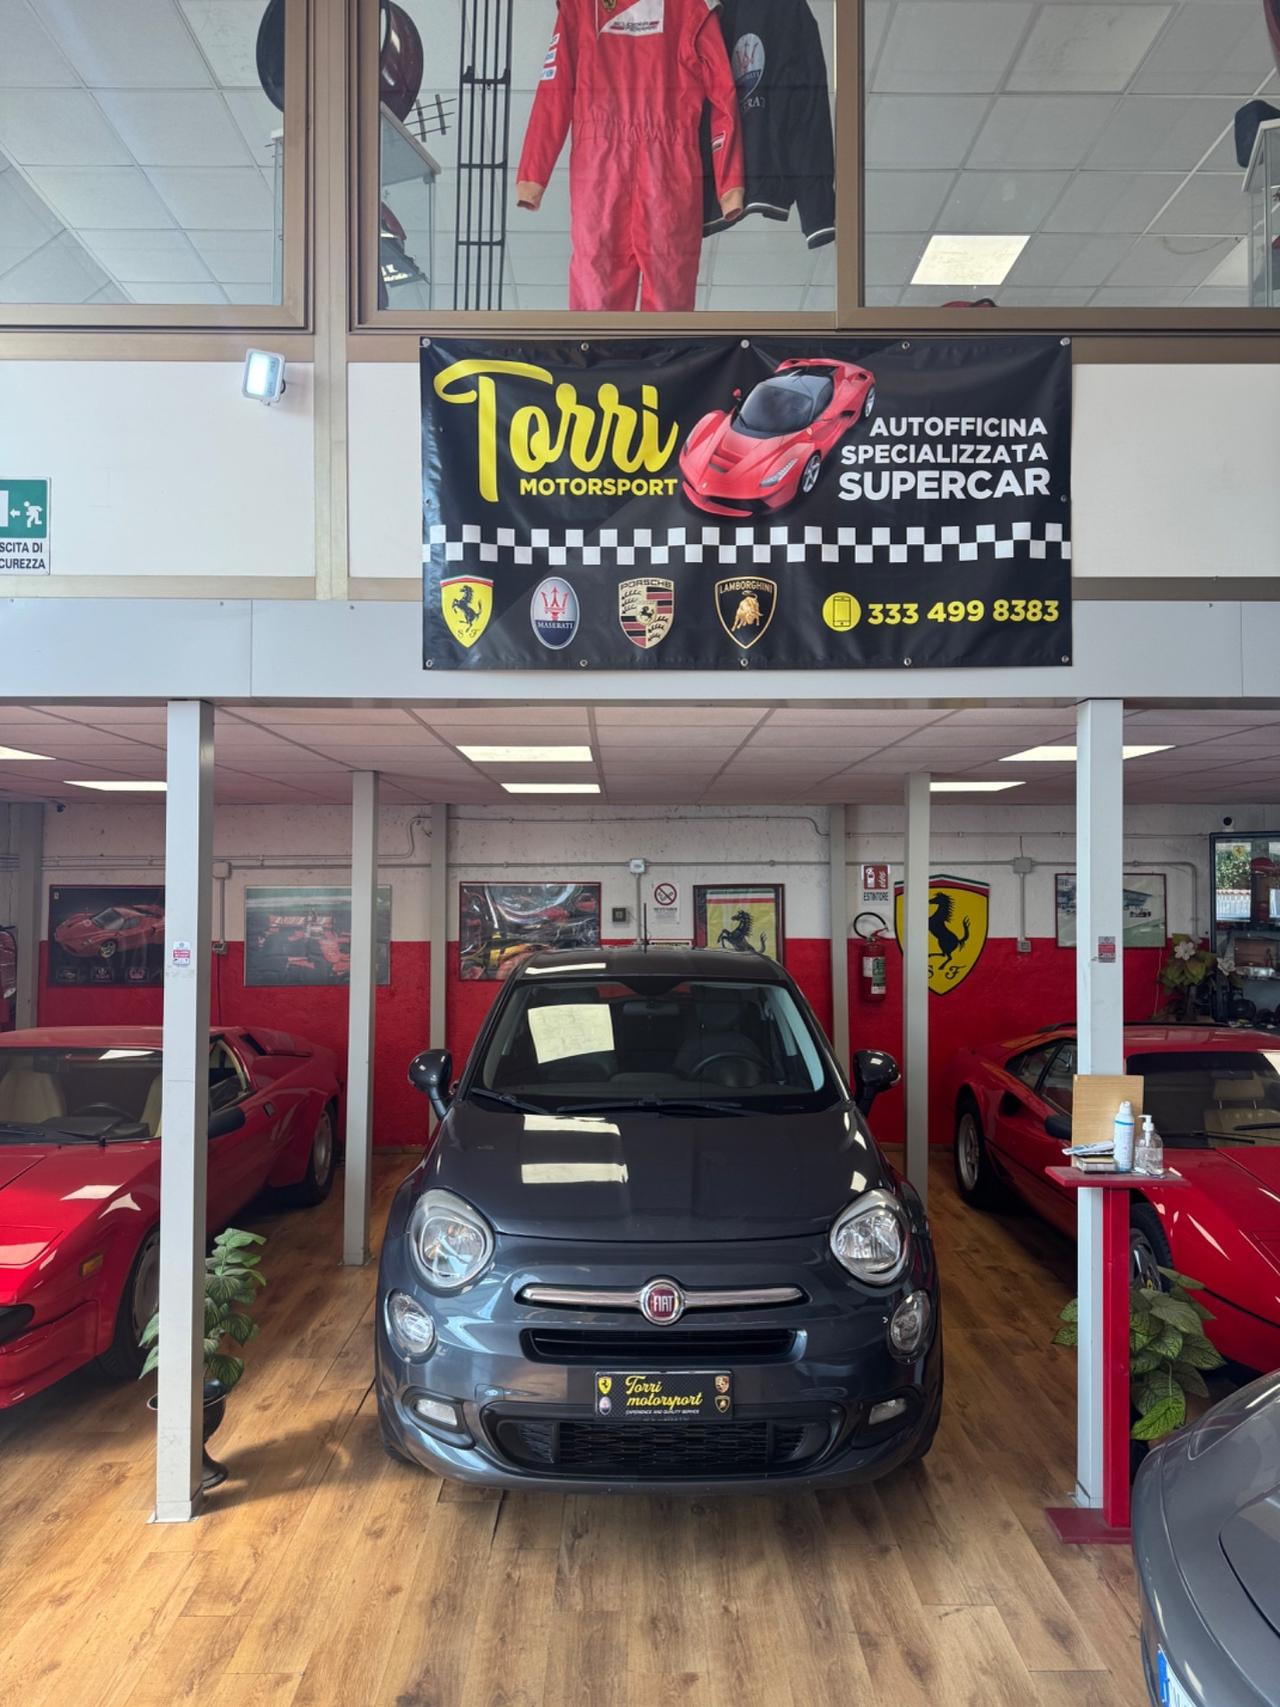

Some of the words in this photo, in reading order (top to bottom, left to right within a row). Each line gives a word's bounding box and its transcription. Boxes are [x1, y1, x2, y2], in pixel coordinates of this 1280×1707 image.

[433, 359, 679, 503] Torri
[869, 416, 1048, 438] AUTOFFICINA
[840, 442, 1049, 465] SPECIALIZZATA
[519, 477, 679, 496] MOTORSPORT
[838, 467, 1051, 501] SUPERCAR
[0, 542, 29, 553] SCITA
[32, 542, 43, 553] DI
[0, 558, 46, 569] CUREZZA
[620, 579, 672, 591] PORSCHE
[719, 581, 773, 594] LAMBORGHINI
[867, 603, 919, 625] 333
[927, 600, 984, 623] 499
[992, 598, 1059, 622] 8383
[537, 621, 573, 629] MASERATI
[653, 1295, 674, 1313] FIAT
[625, 1375, 662, 1395] Torri
[626, 1392, 703, 1411] motorsport
